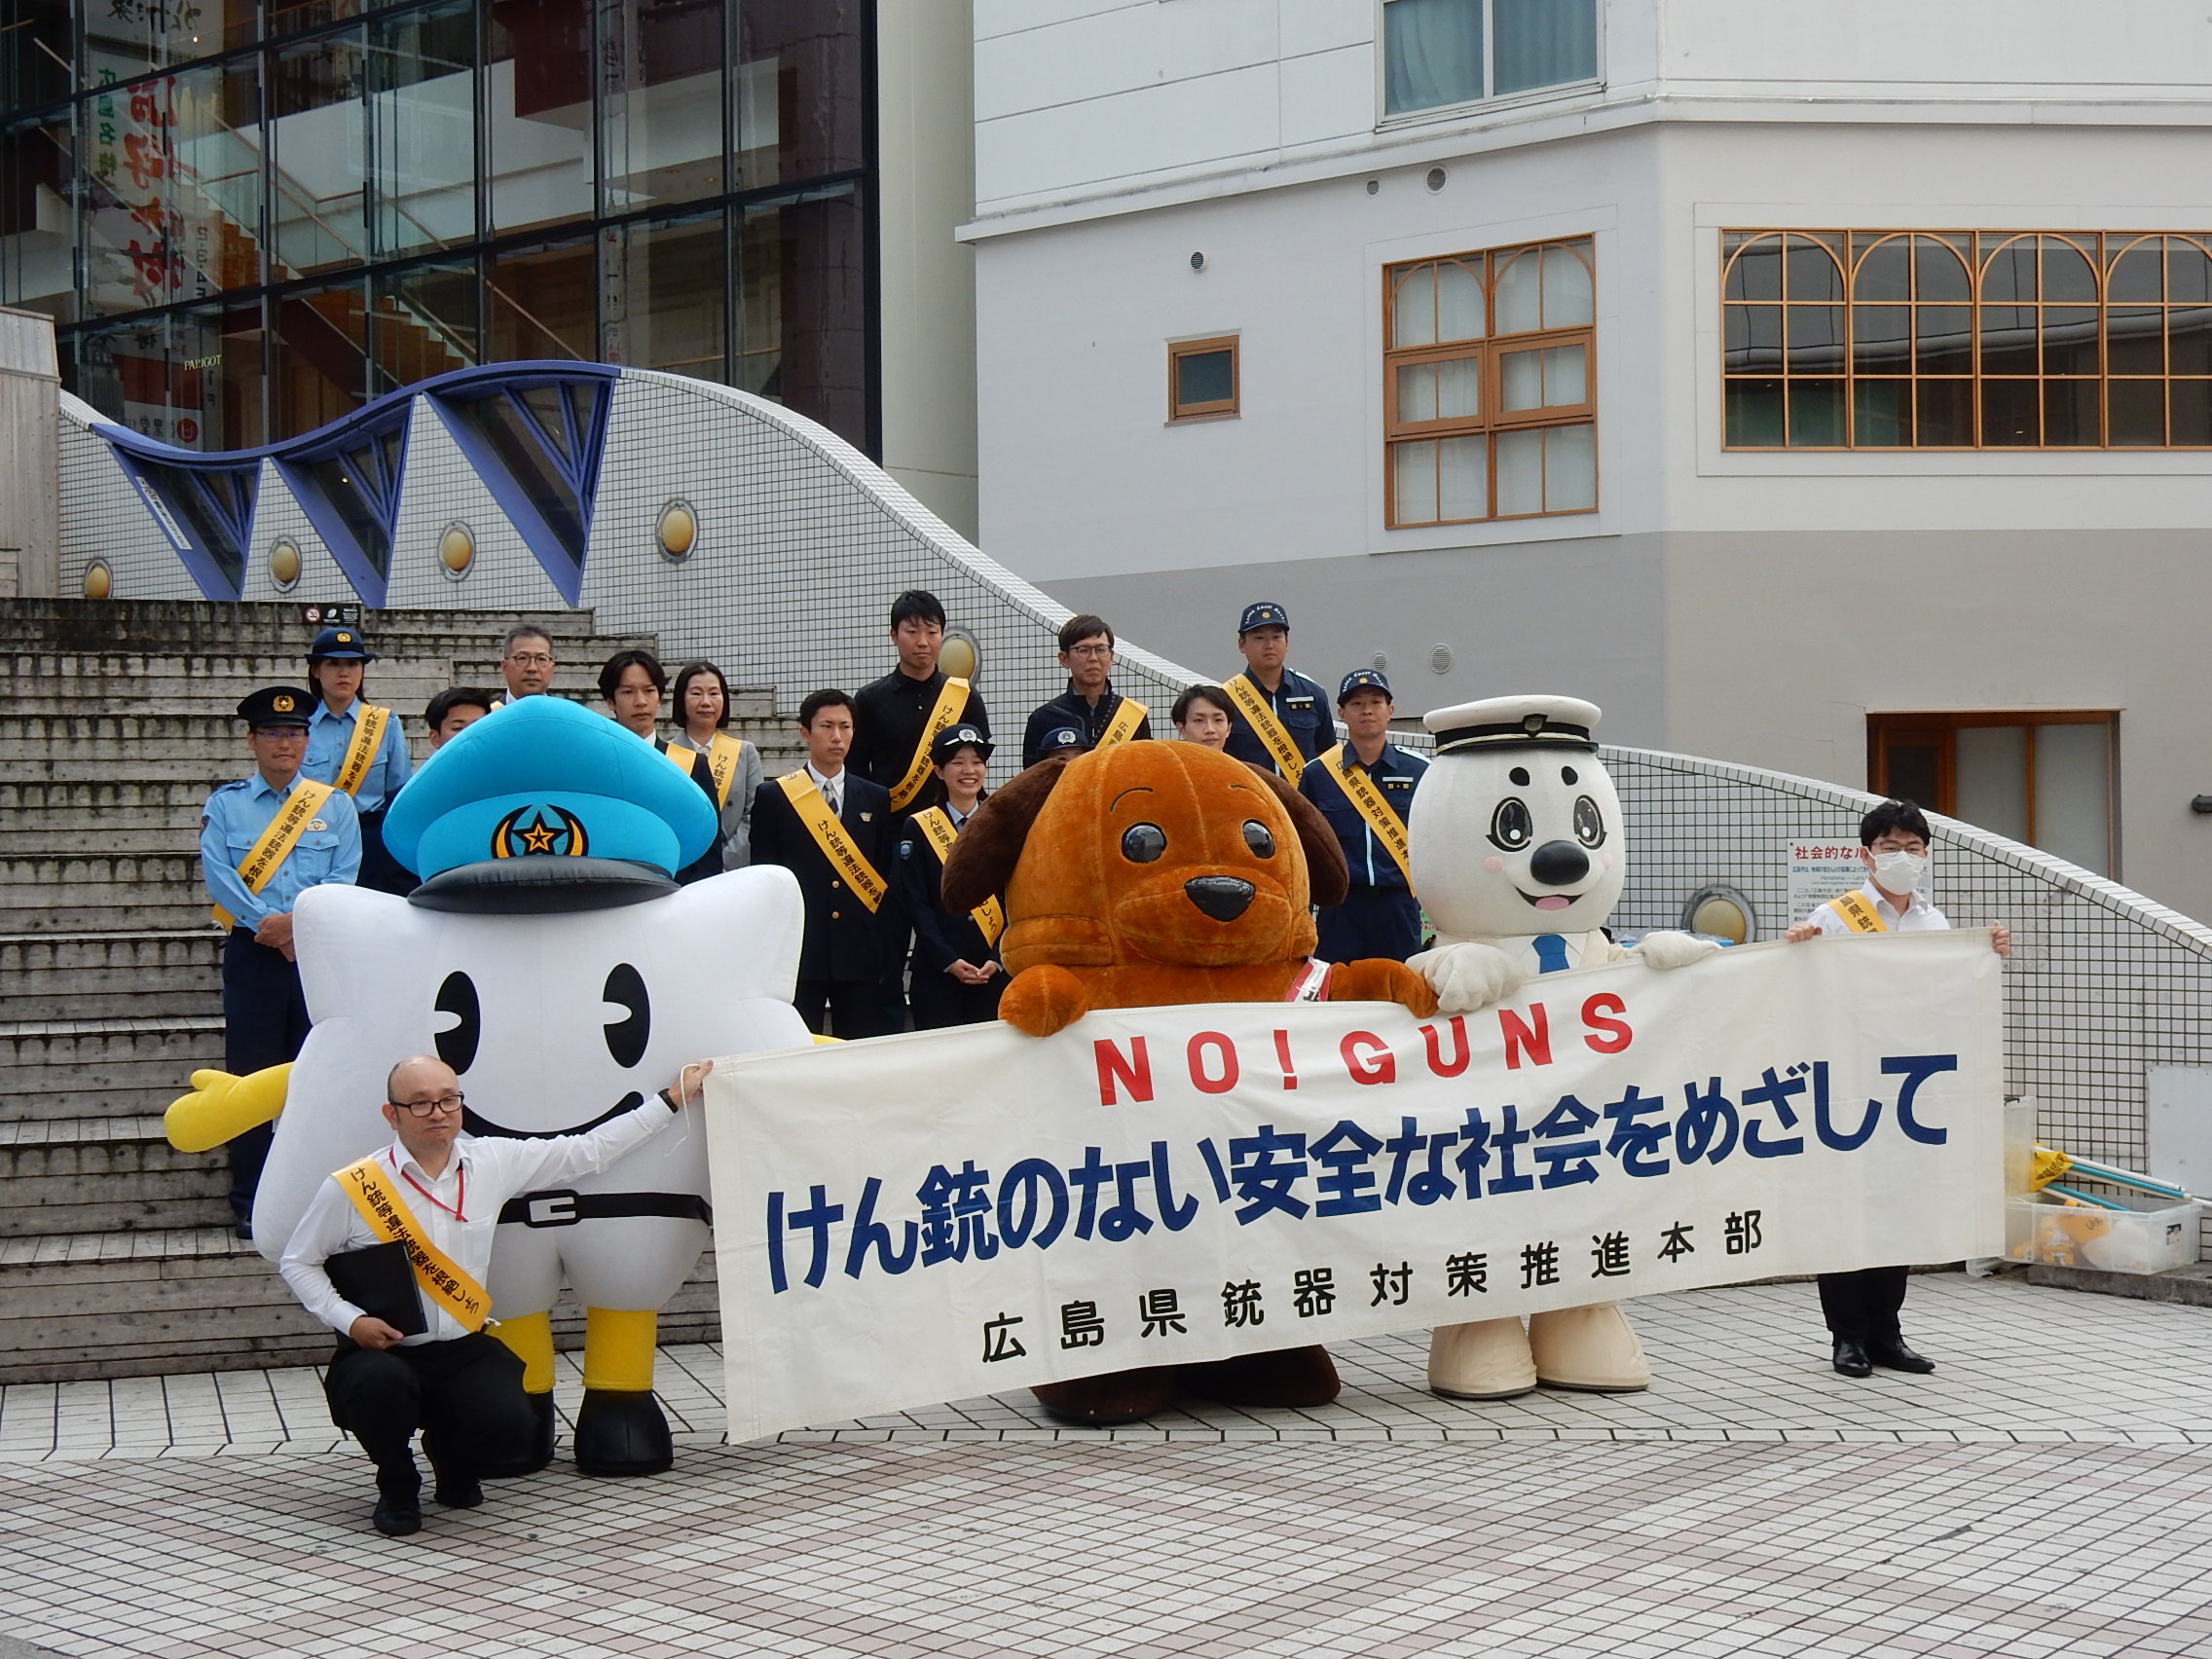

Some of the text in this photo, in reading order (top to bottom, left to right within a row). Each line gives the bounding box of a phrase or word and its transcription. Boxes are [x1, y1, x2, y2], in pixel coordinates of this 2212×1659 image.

[767, 1055, 1958, 1294] けん銃のない安全な社会をめざして
[982, 1208, 1763, 1365] 広島県銃器対策推進本部
